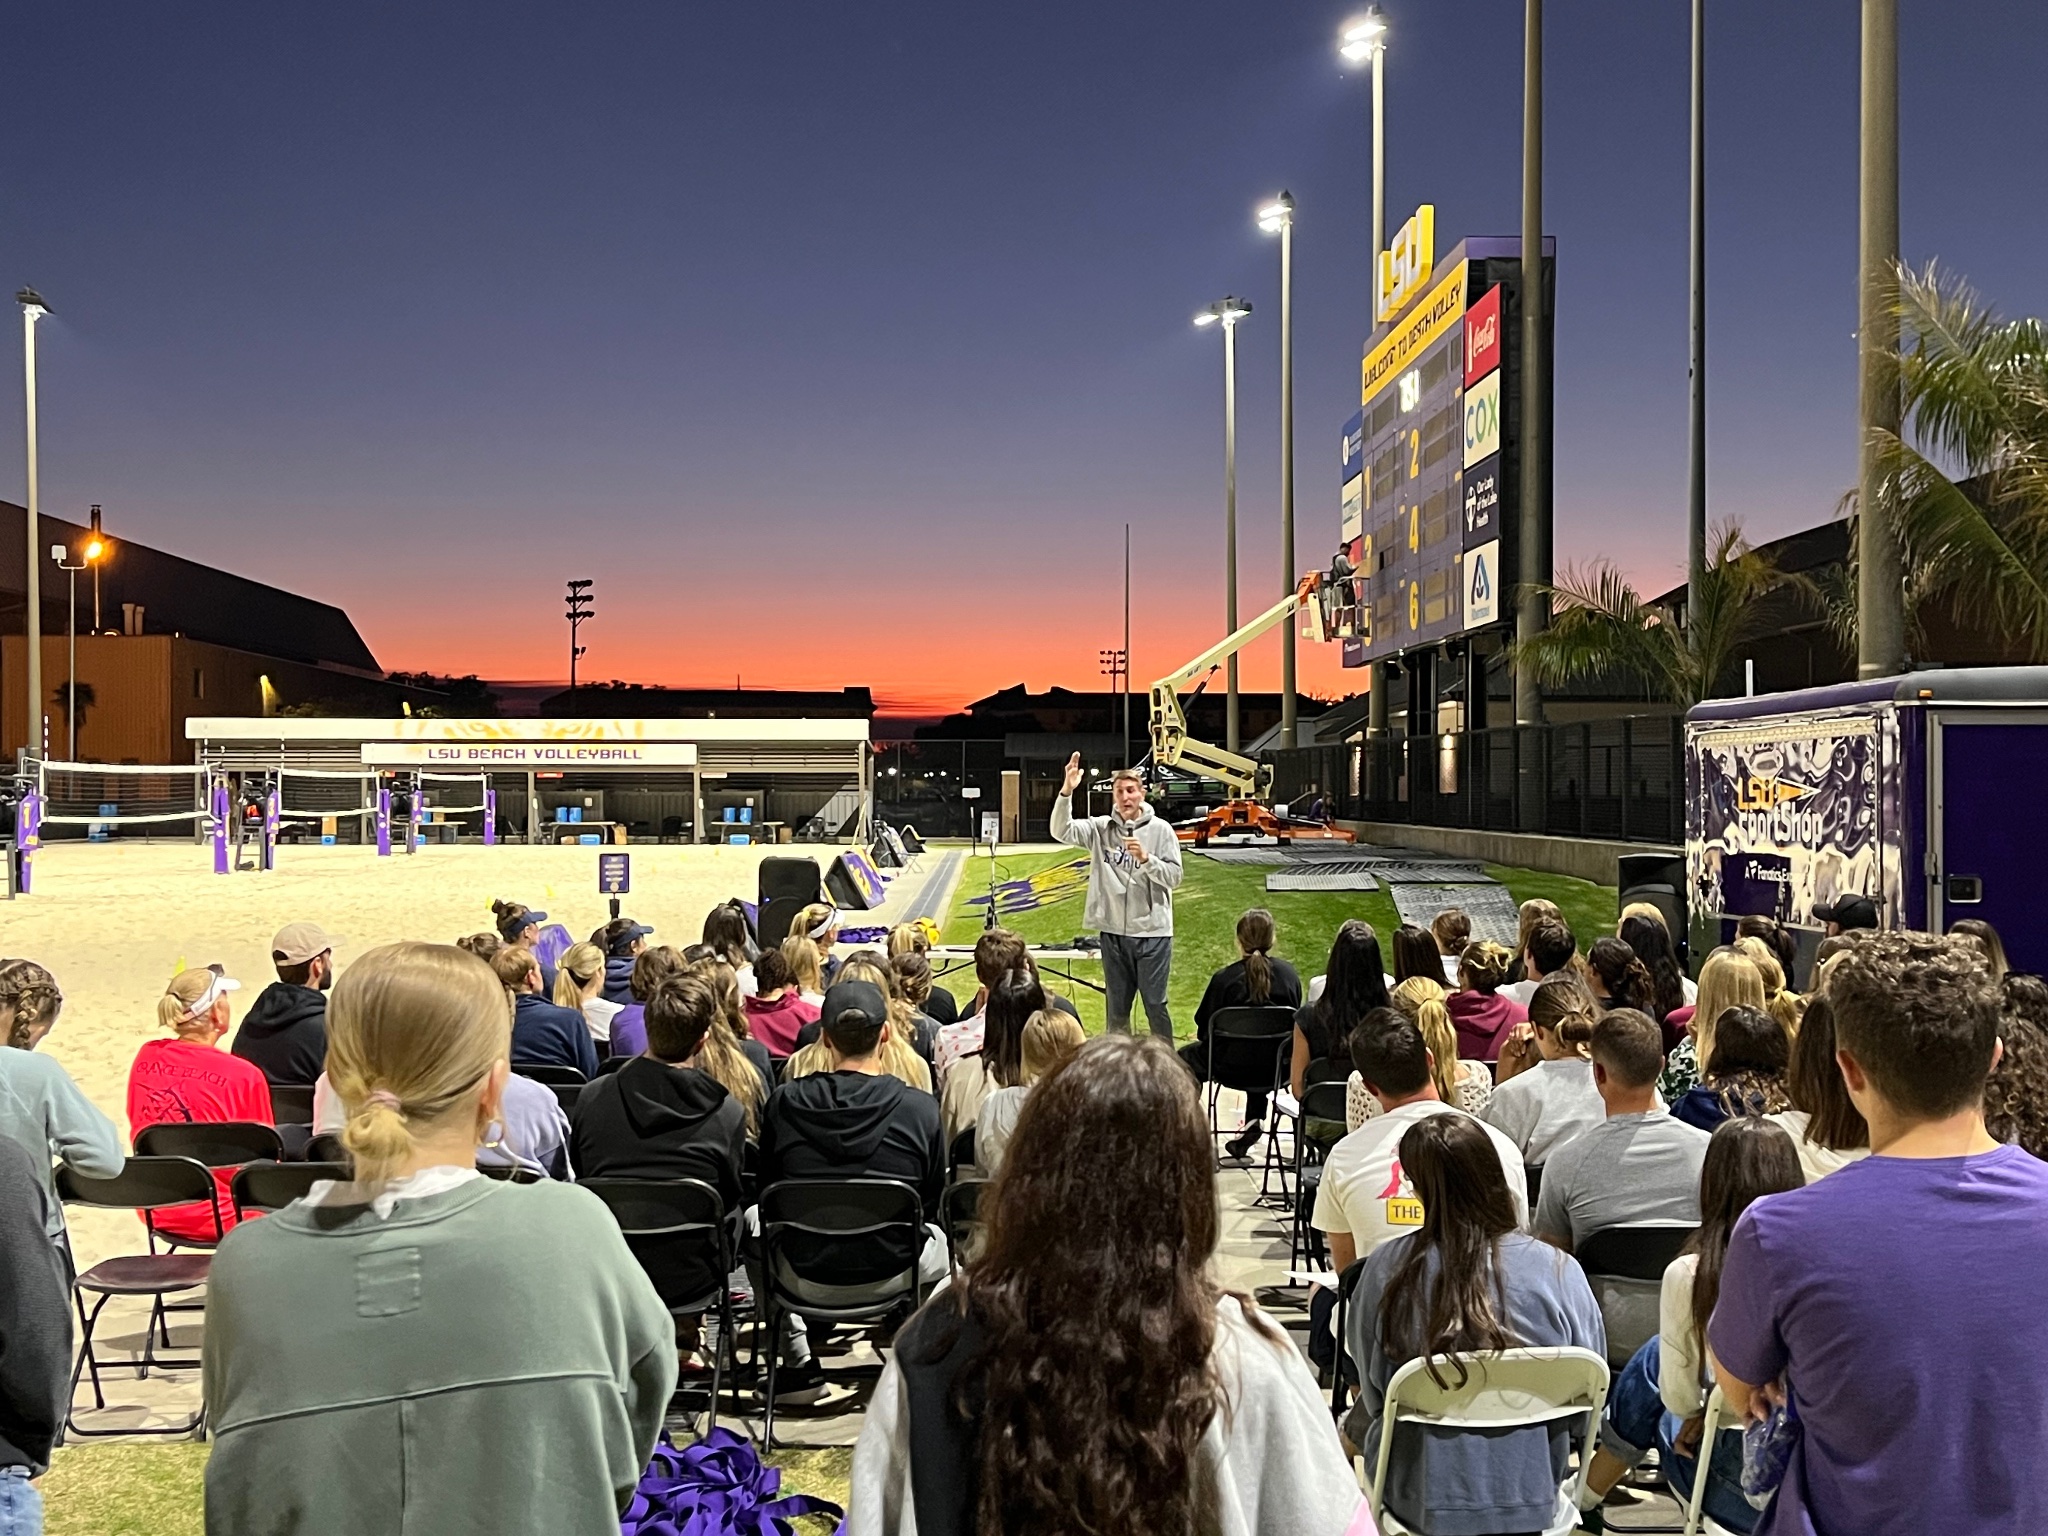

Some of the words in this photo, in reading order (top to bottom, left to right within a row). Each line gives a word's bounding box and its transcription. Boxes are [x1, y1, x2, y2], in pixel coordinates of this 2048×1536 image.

[1377, 204, 1434, 322] LSU
[1398, 335, 1407, 359] TO
[1466, 389, 1498, 449] COX
[1410, 429, 1419, 480] 2
[1409, 505, 1419, 554] 4
[1410, 581, 1419, 631] 6
[428, 748, 461, 759] LSU
[468, 748, 526, 759] BEACH
[534, 748, 643, 760] VOLLEYBALL
[1737, 776, 1775, 810] LSU
[1392, 1205, 1423, 1219] THE
